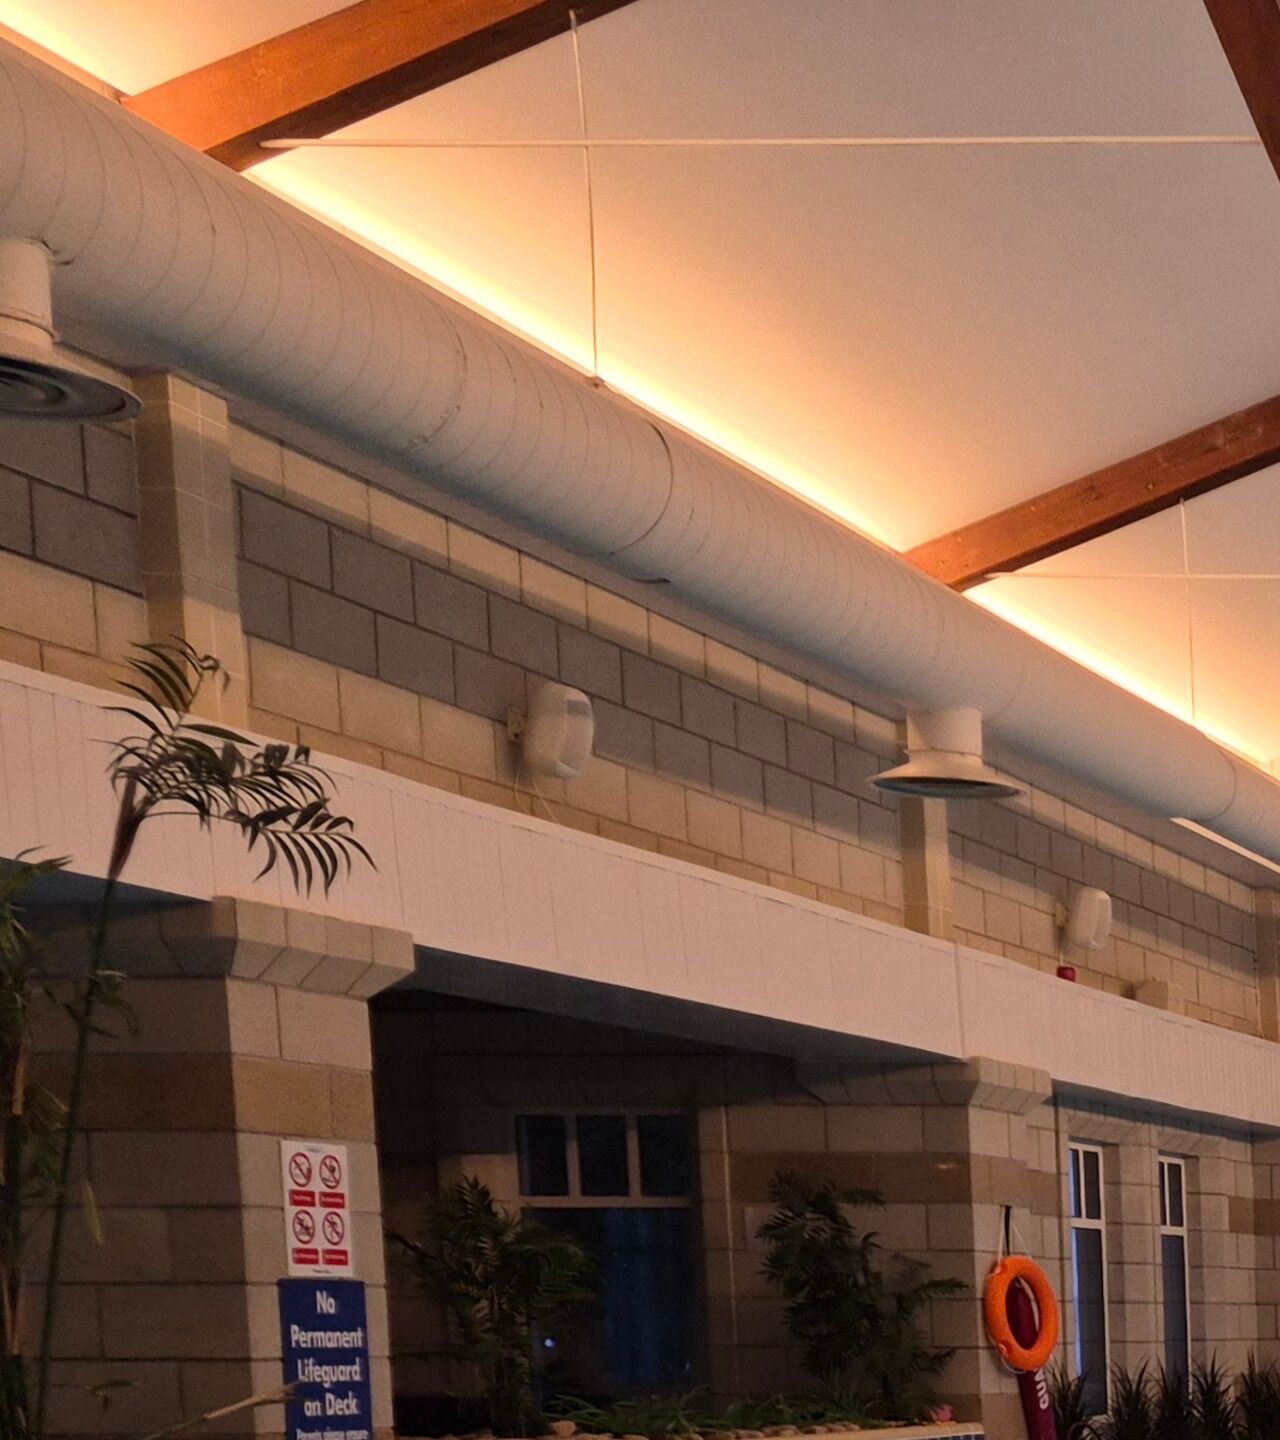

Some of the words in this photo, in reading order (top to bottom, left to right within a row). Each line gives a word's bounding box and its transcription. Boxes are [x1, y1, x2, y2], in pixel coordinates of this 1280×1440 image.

[316, 1290, 336, 1314] No
[290, 1324, 363, 1348] Permanent
[297, 1356, 361, 1388] Lifeguard
[1034, 1368, 1049, 1410] GUA
[304, 1400, 321, 1416] on
[325, 1391, 359, 1416] Deck
